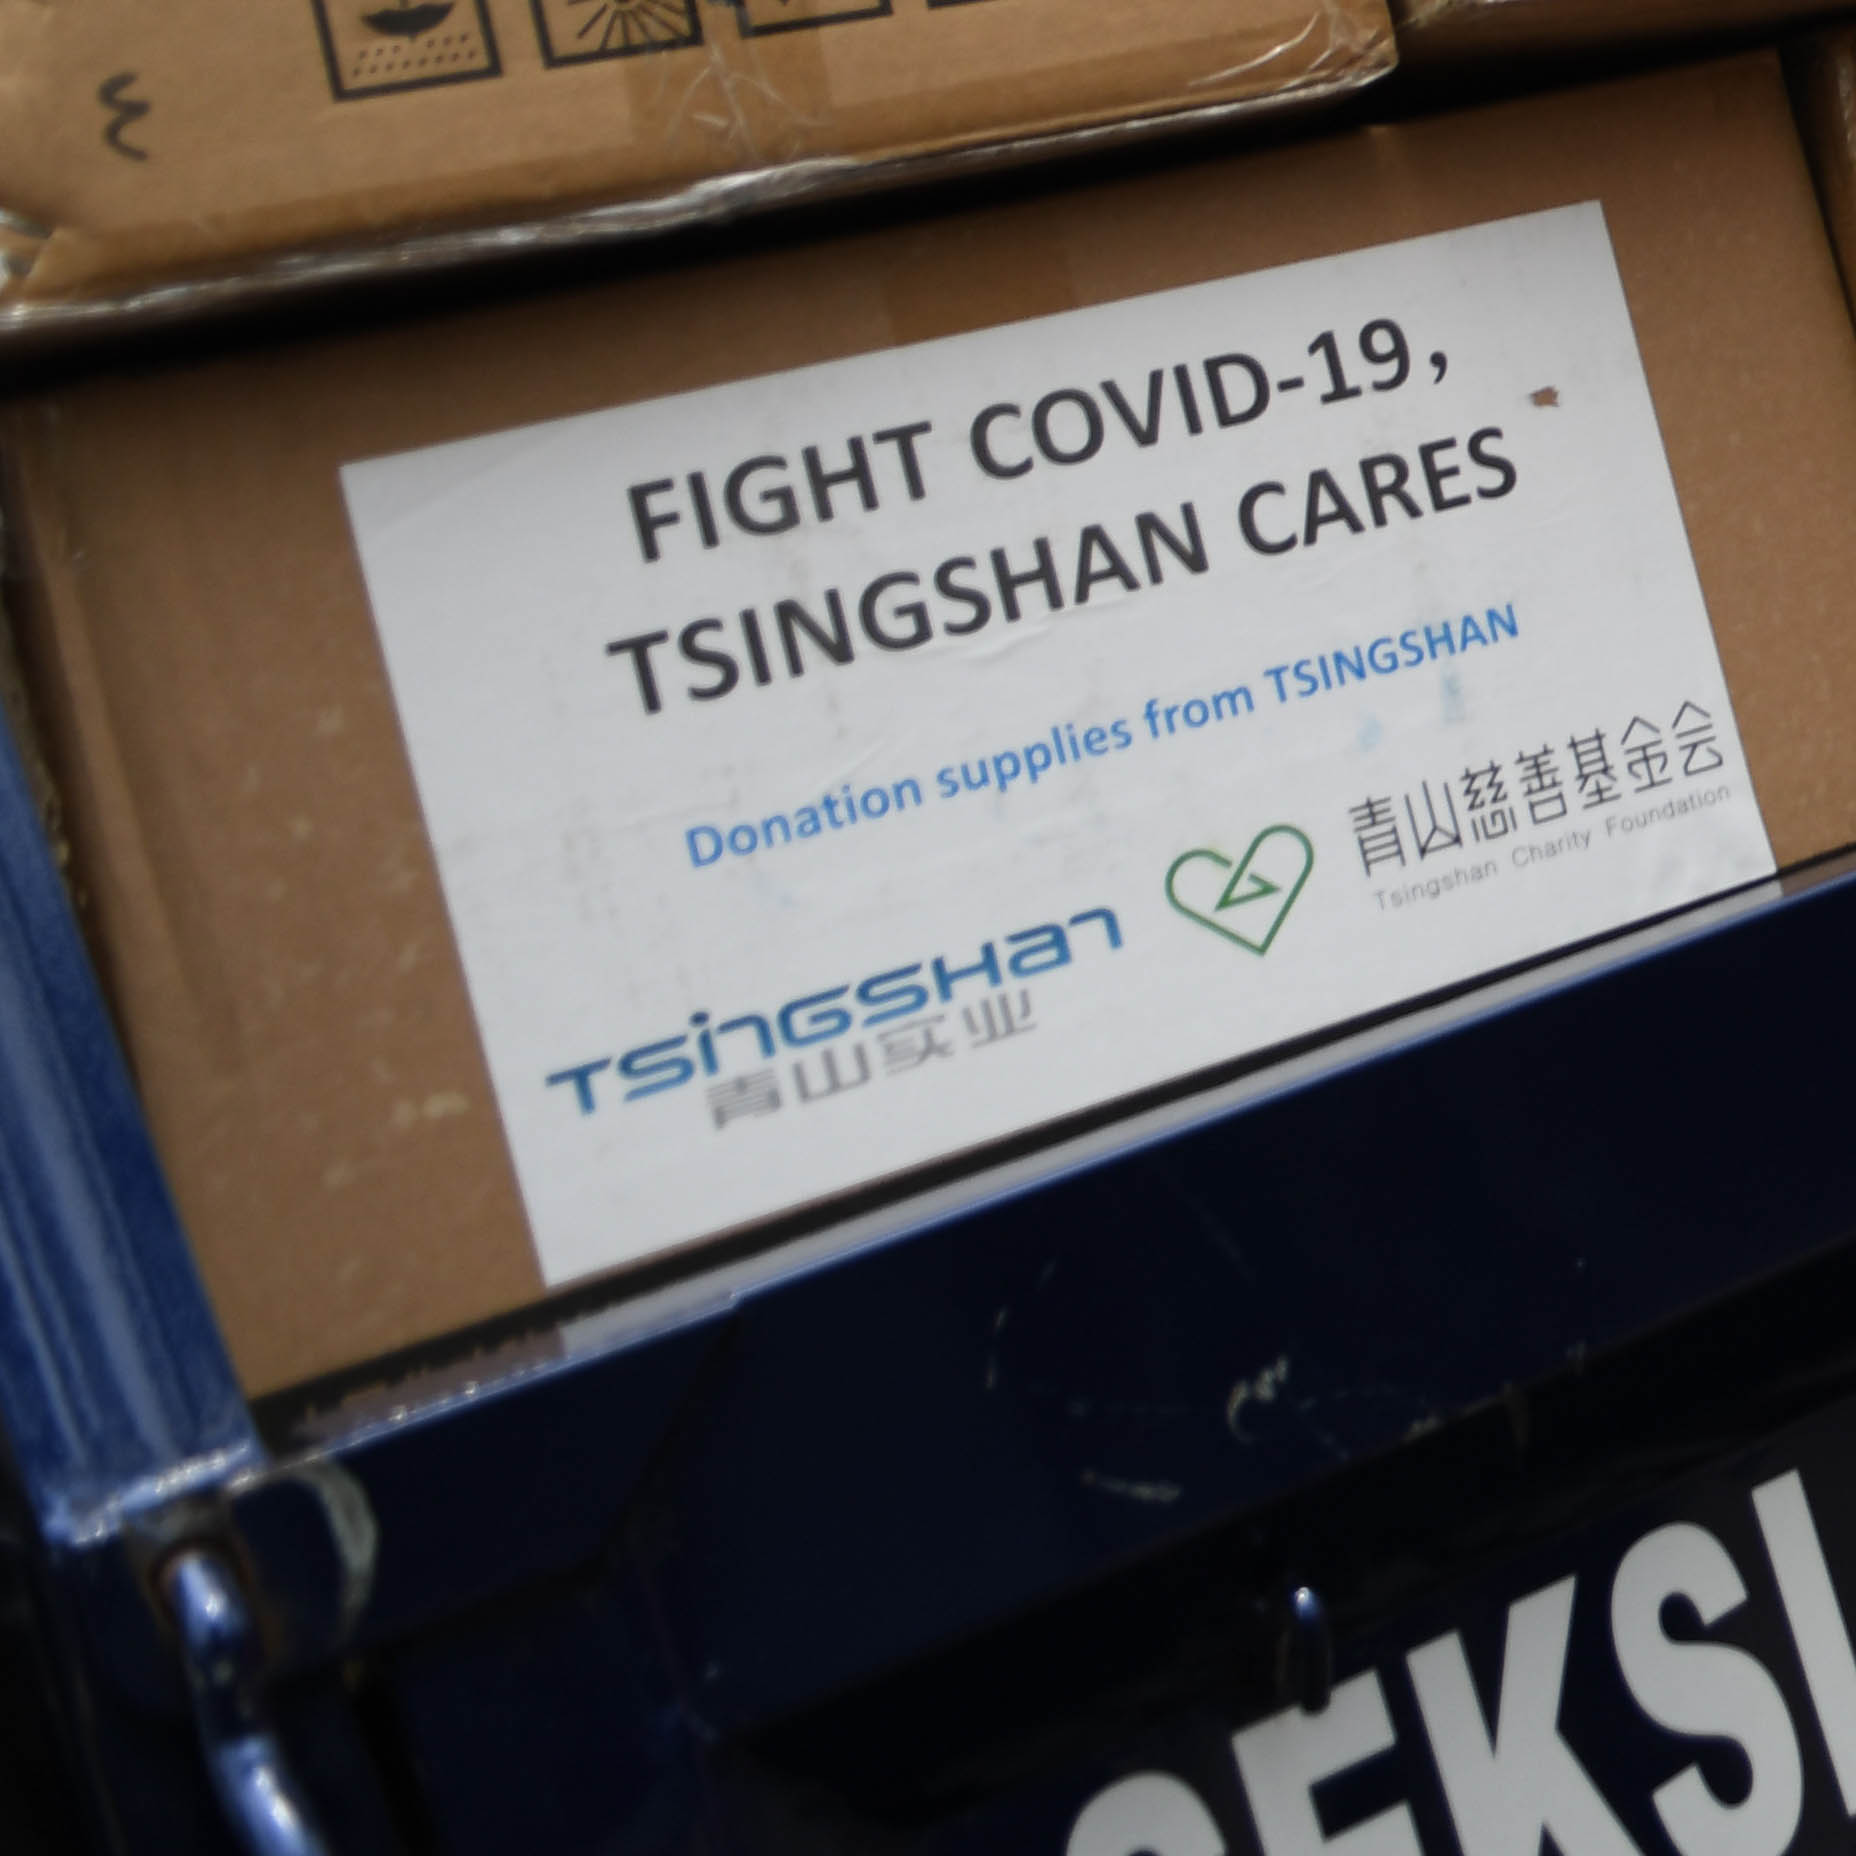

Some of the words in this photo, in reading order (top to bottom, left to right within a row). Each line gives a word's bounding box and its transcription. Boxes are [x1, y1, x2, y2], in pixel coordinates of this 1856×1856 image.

[625, 418, 938, 566] FIGHT
[966, 316, 1454, 482] COVID-19,
[605, 500, 1215, 716] TSINGSHAN
[1234, 425, 1523, 557] CARES
[685, 771, 927, 872] Donation
[935, 709, 1135, 808] supplies
[1139, 681, 1259, 746] from
[1262, 601, 1523, 707] TSINGSHAN
[1346, 697, 1730, 879] 青山慈善基金会
[1373, 856, 1502, 915] Tsingshan
[1508, 825, 1595, 874] Charity
[1603, 782, 1734, 843] Foundation
